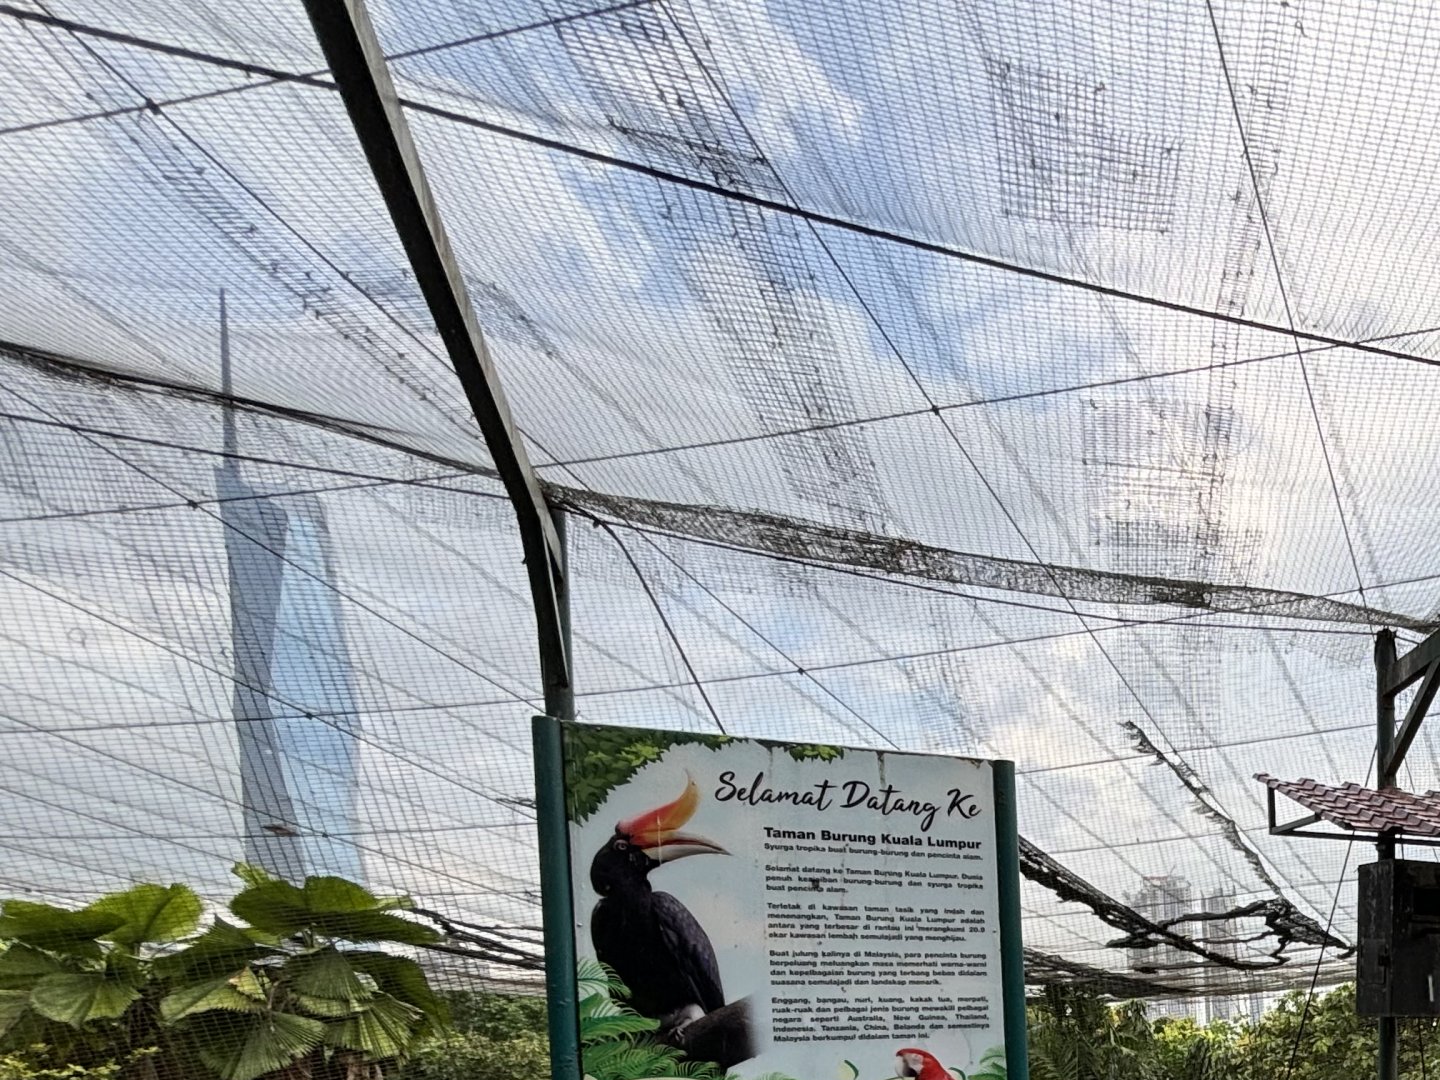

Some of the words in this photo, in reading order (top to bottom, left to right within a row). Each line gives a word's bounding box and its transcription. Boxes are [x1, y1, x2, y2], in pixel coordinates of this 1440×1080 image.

[714, 771, 837, 811] Selamat
[840, 780, 941, 832] Datang
[947, 788, 982, 819] Ke
[764, 827, 816, 841] Taman
[821, 830, 876, 845] Burung
[882, 833, 922, 846] Kuala
[928, 836, 981, 850] Lumpur
